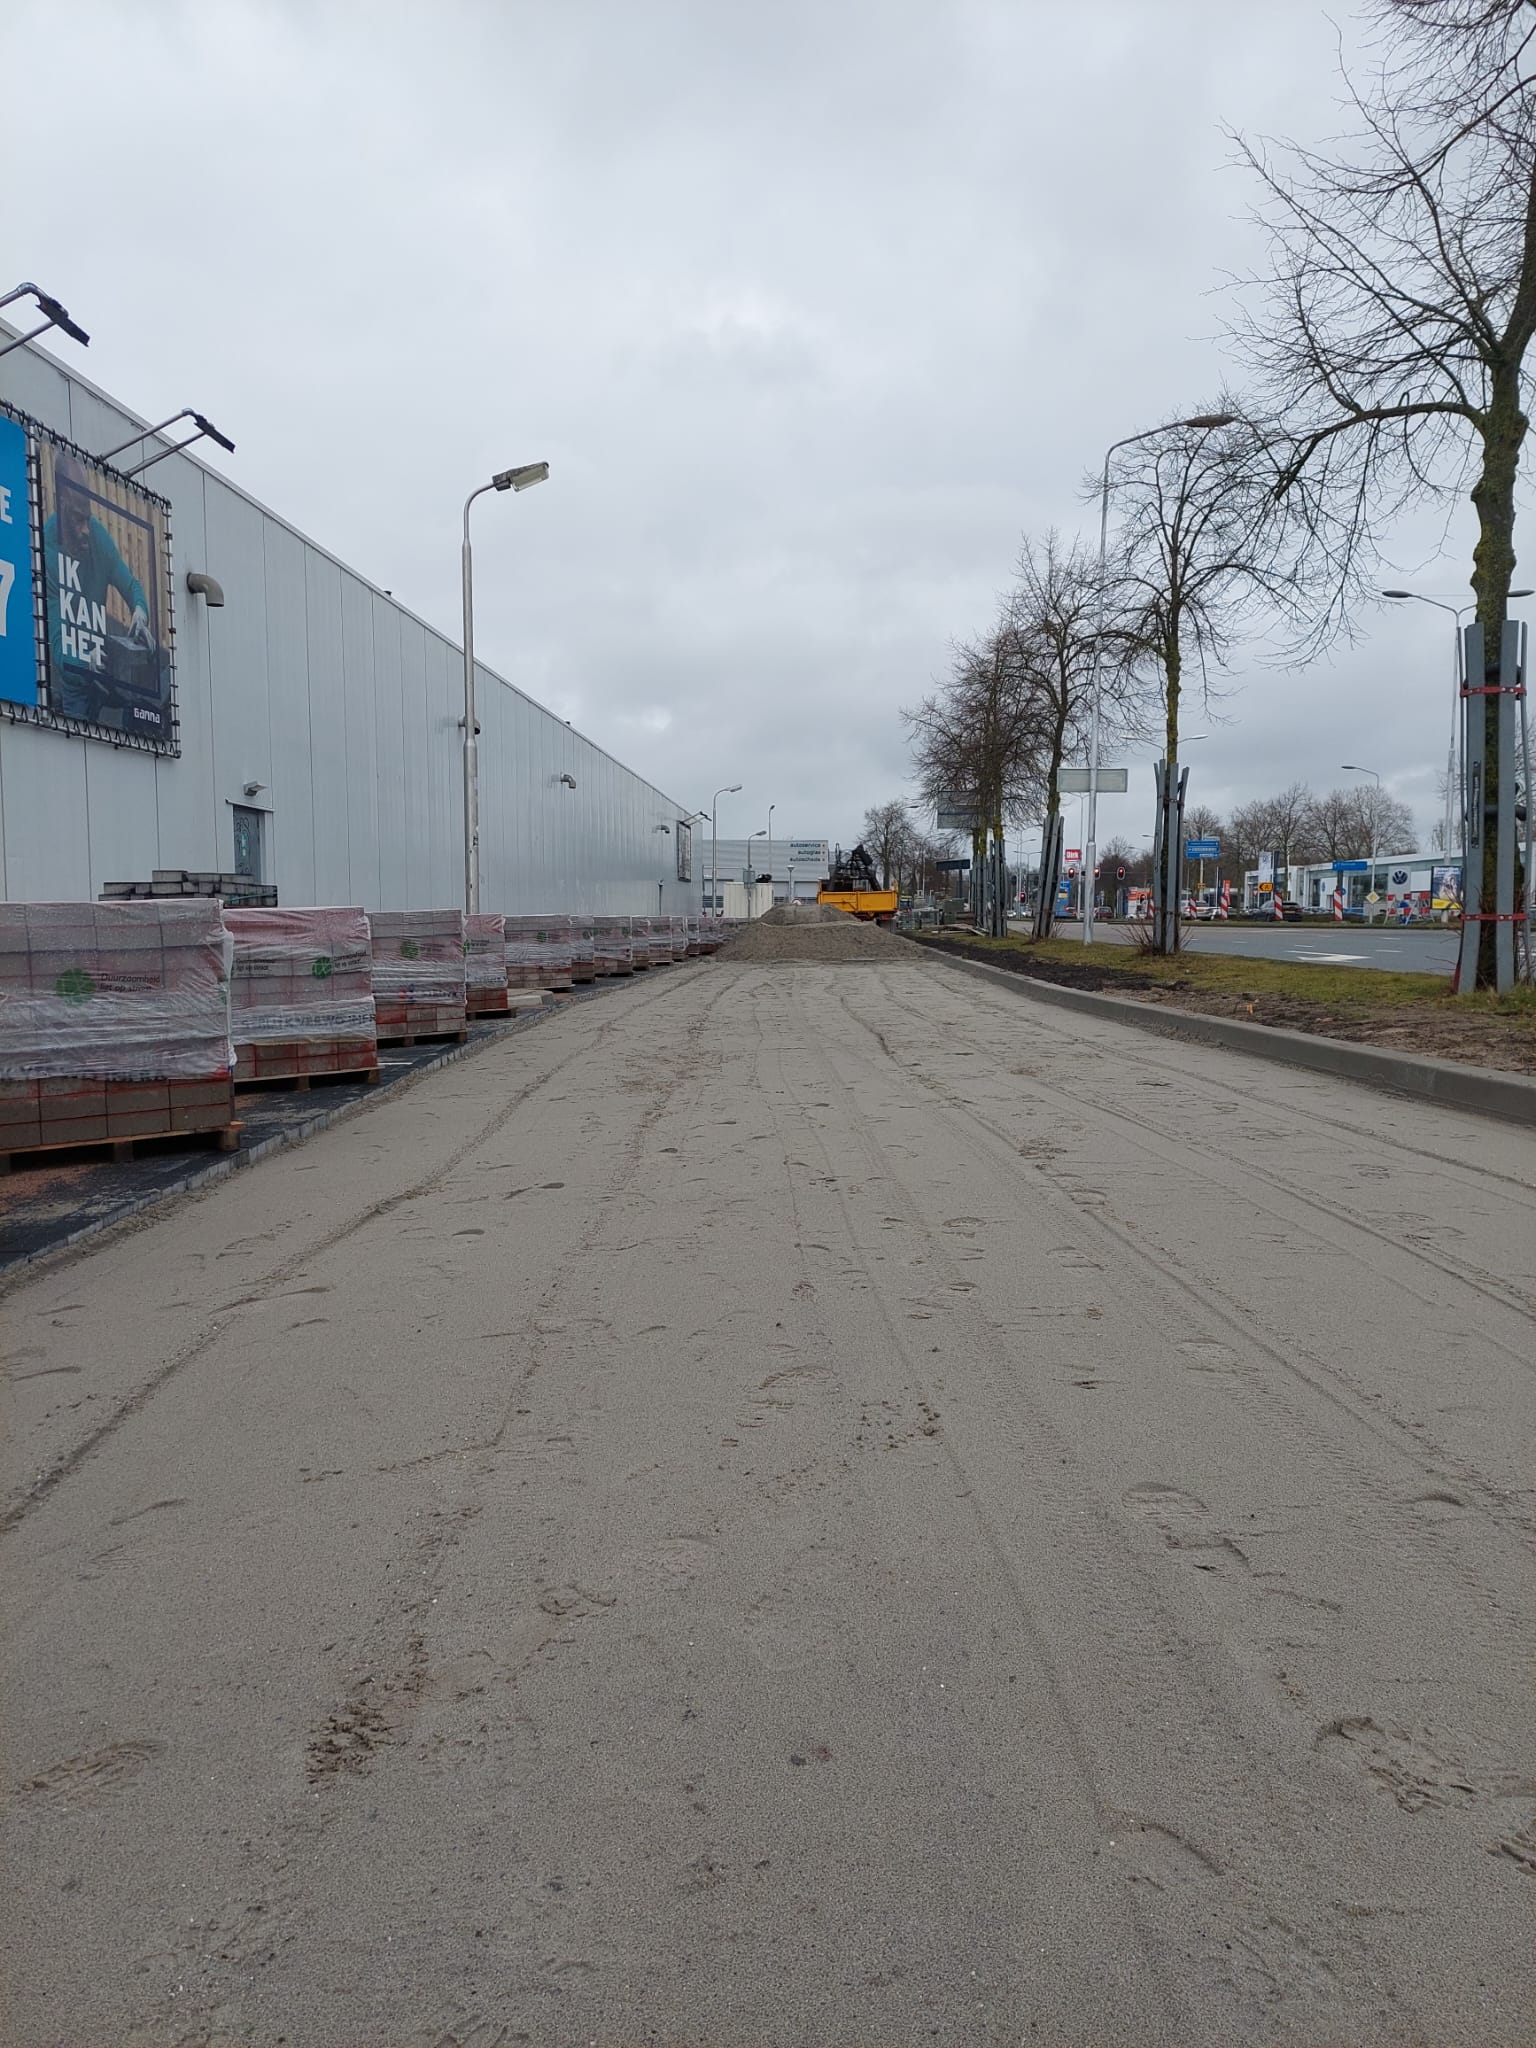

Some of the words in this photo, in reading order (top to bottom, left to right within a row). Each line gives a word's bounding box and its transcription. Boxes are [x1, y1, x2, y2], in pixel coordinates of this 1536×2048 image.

[58, 552, 82, 592] IK
[59, 587, 107, 635] KAN
[61, 623, 105, 666] HET
